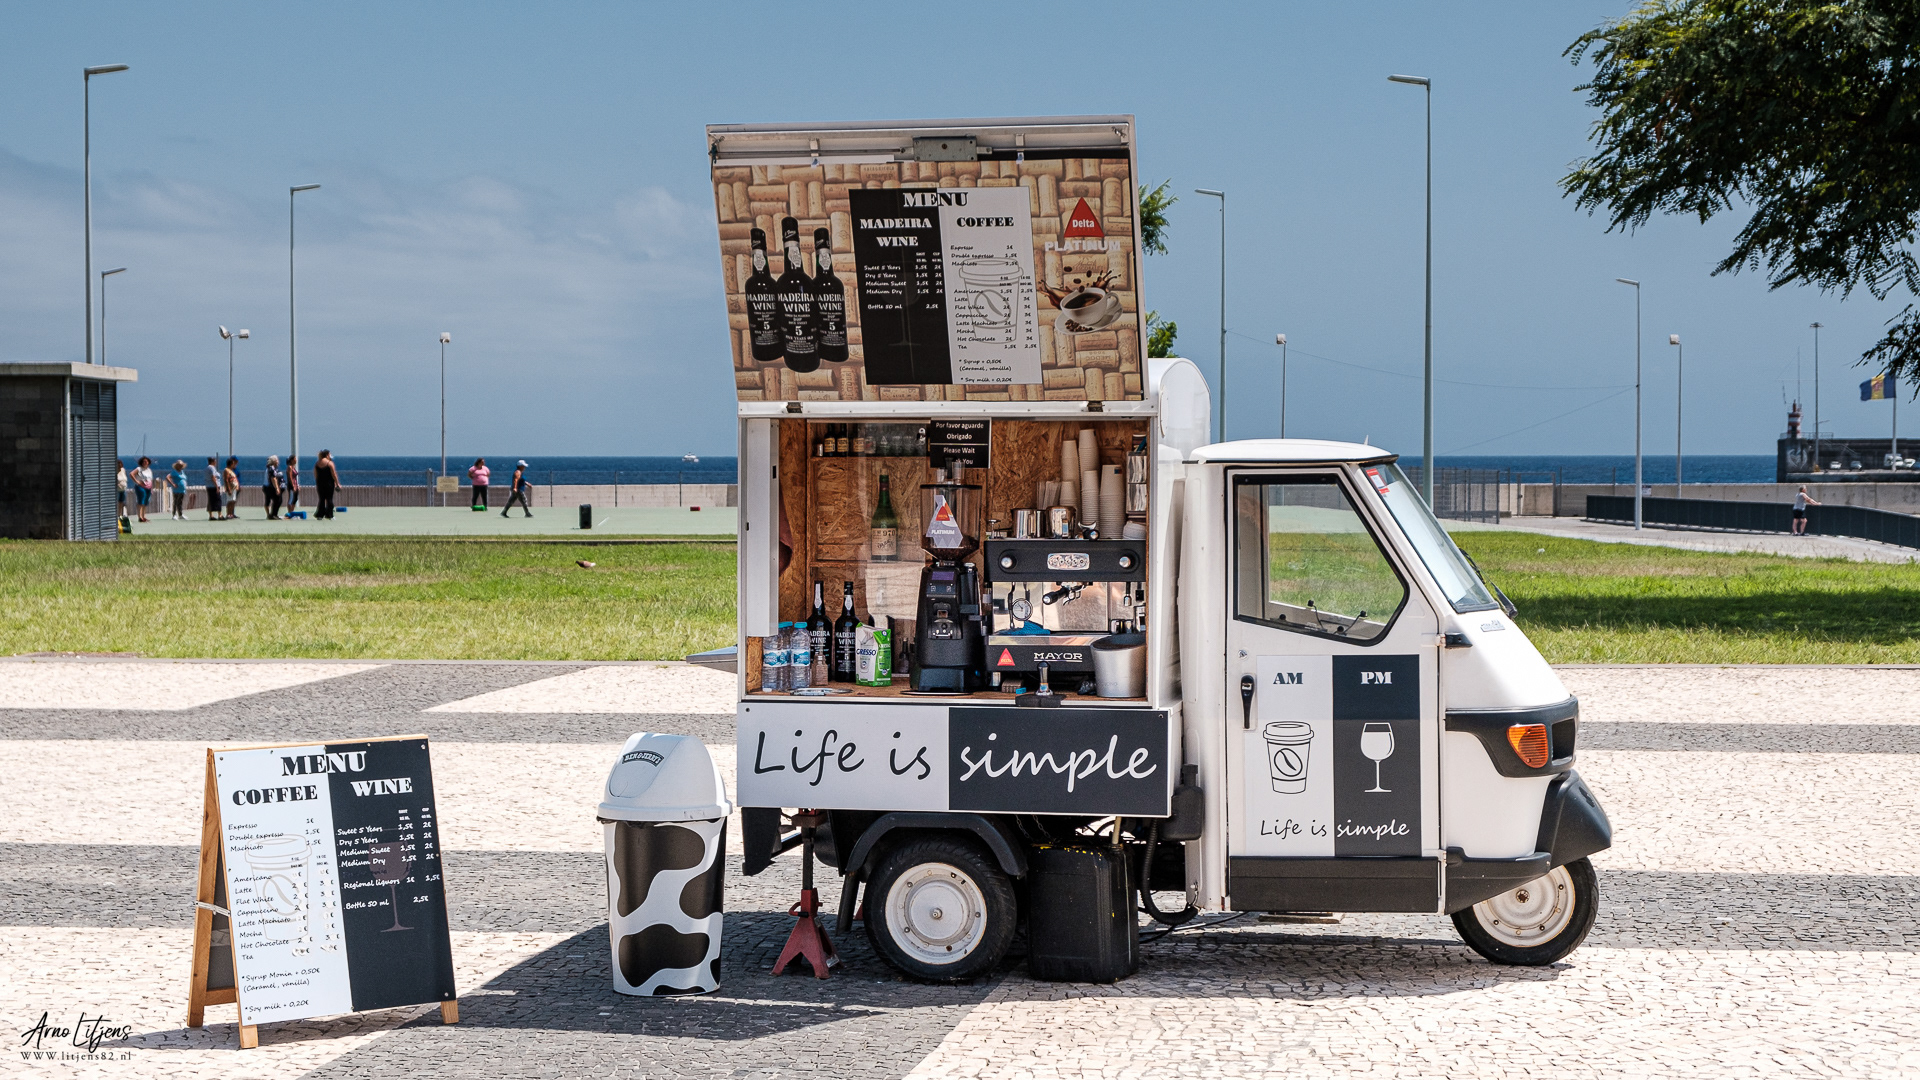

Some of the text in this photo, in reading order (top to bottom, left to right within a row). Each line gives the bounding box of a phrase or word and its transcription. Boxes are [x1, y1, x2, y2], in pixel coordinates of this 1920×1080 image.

[903, 192, 968, 208] MENU
[860, 218, 932, 228] MADEIRA
[956, 216, 1014, 228] COFFEE
[1072, 219, 1095, 228] Delta
[876, 236, 918, 247] WINE
[1045, 240, 1121, 252] PLATINUM
[777, 292, 815, 302] MADEIRA
[752, 302, 776, 310] WINE
[783, 303, 810, 312] WINE
[818, 302, 842, 311] WINE
[763, 321, 770, 330] 5
[829, 322, 835, 331] 5
[795, 326, 802, 336] 5
[1273, 672, 1303, 684] AM
[1361, 672, 1392, 684] PM
[281, 751, 367, 776] MENU
[754, 729, 1158, 793] Life is simple
[350, 777, 413, 797] WINE
[233, 785, 318, 806] COFFEE
[1261, 819, 1410, 840] Life is simple
[234, 875, 272, 883] Americano
[237, 908, 278, 916] Cappuccino
[255, 939, 290, 948] Chocolate
